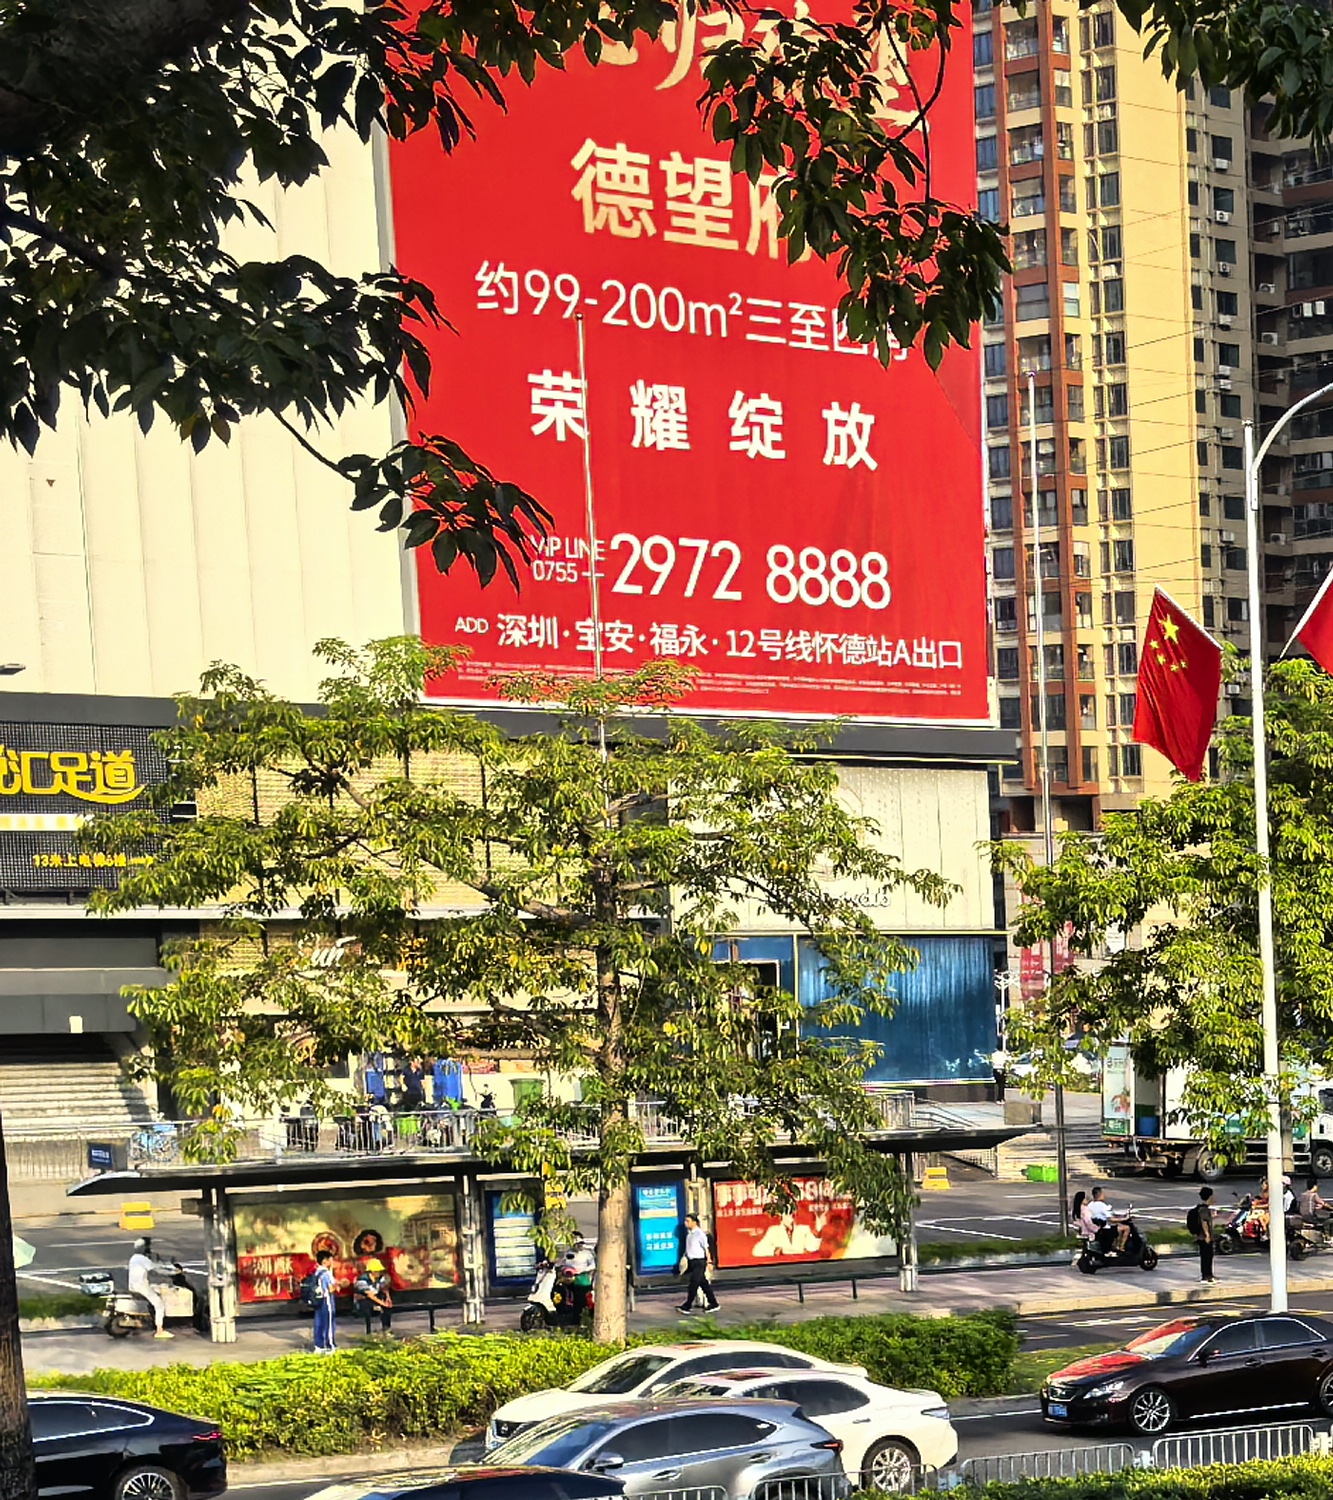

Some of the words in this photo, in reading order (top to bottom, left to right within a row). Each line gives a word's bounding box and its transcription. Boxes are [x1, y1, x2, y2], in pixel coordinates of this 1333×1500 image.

[527, 368, 879, 472] 荣耀绽放
[610, 532, 743, 601] 2972
[765, 544, 892, 610] 8888
[454, 616, 490, 634] ADD
